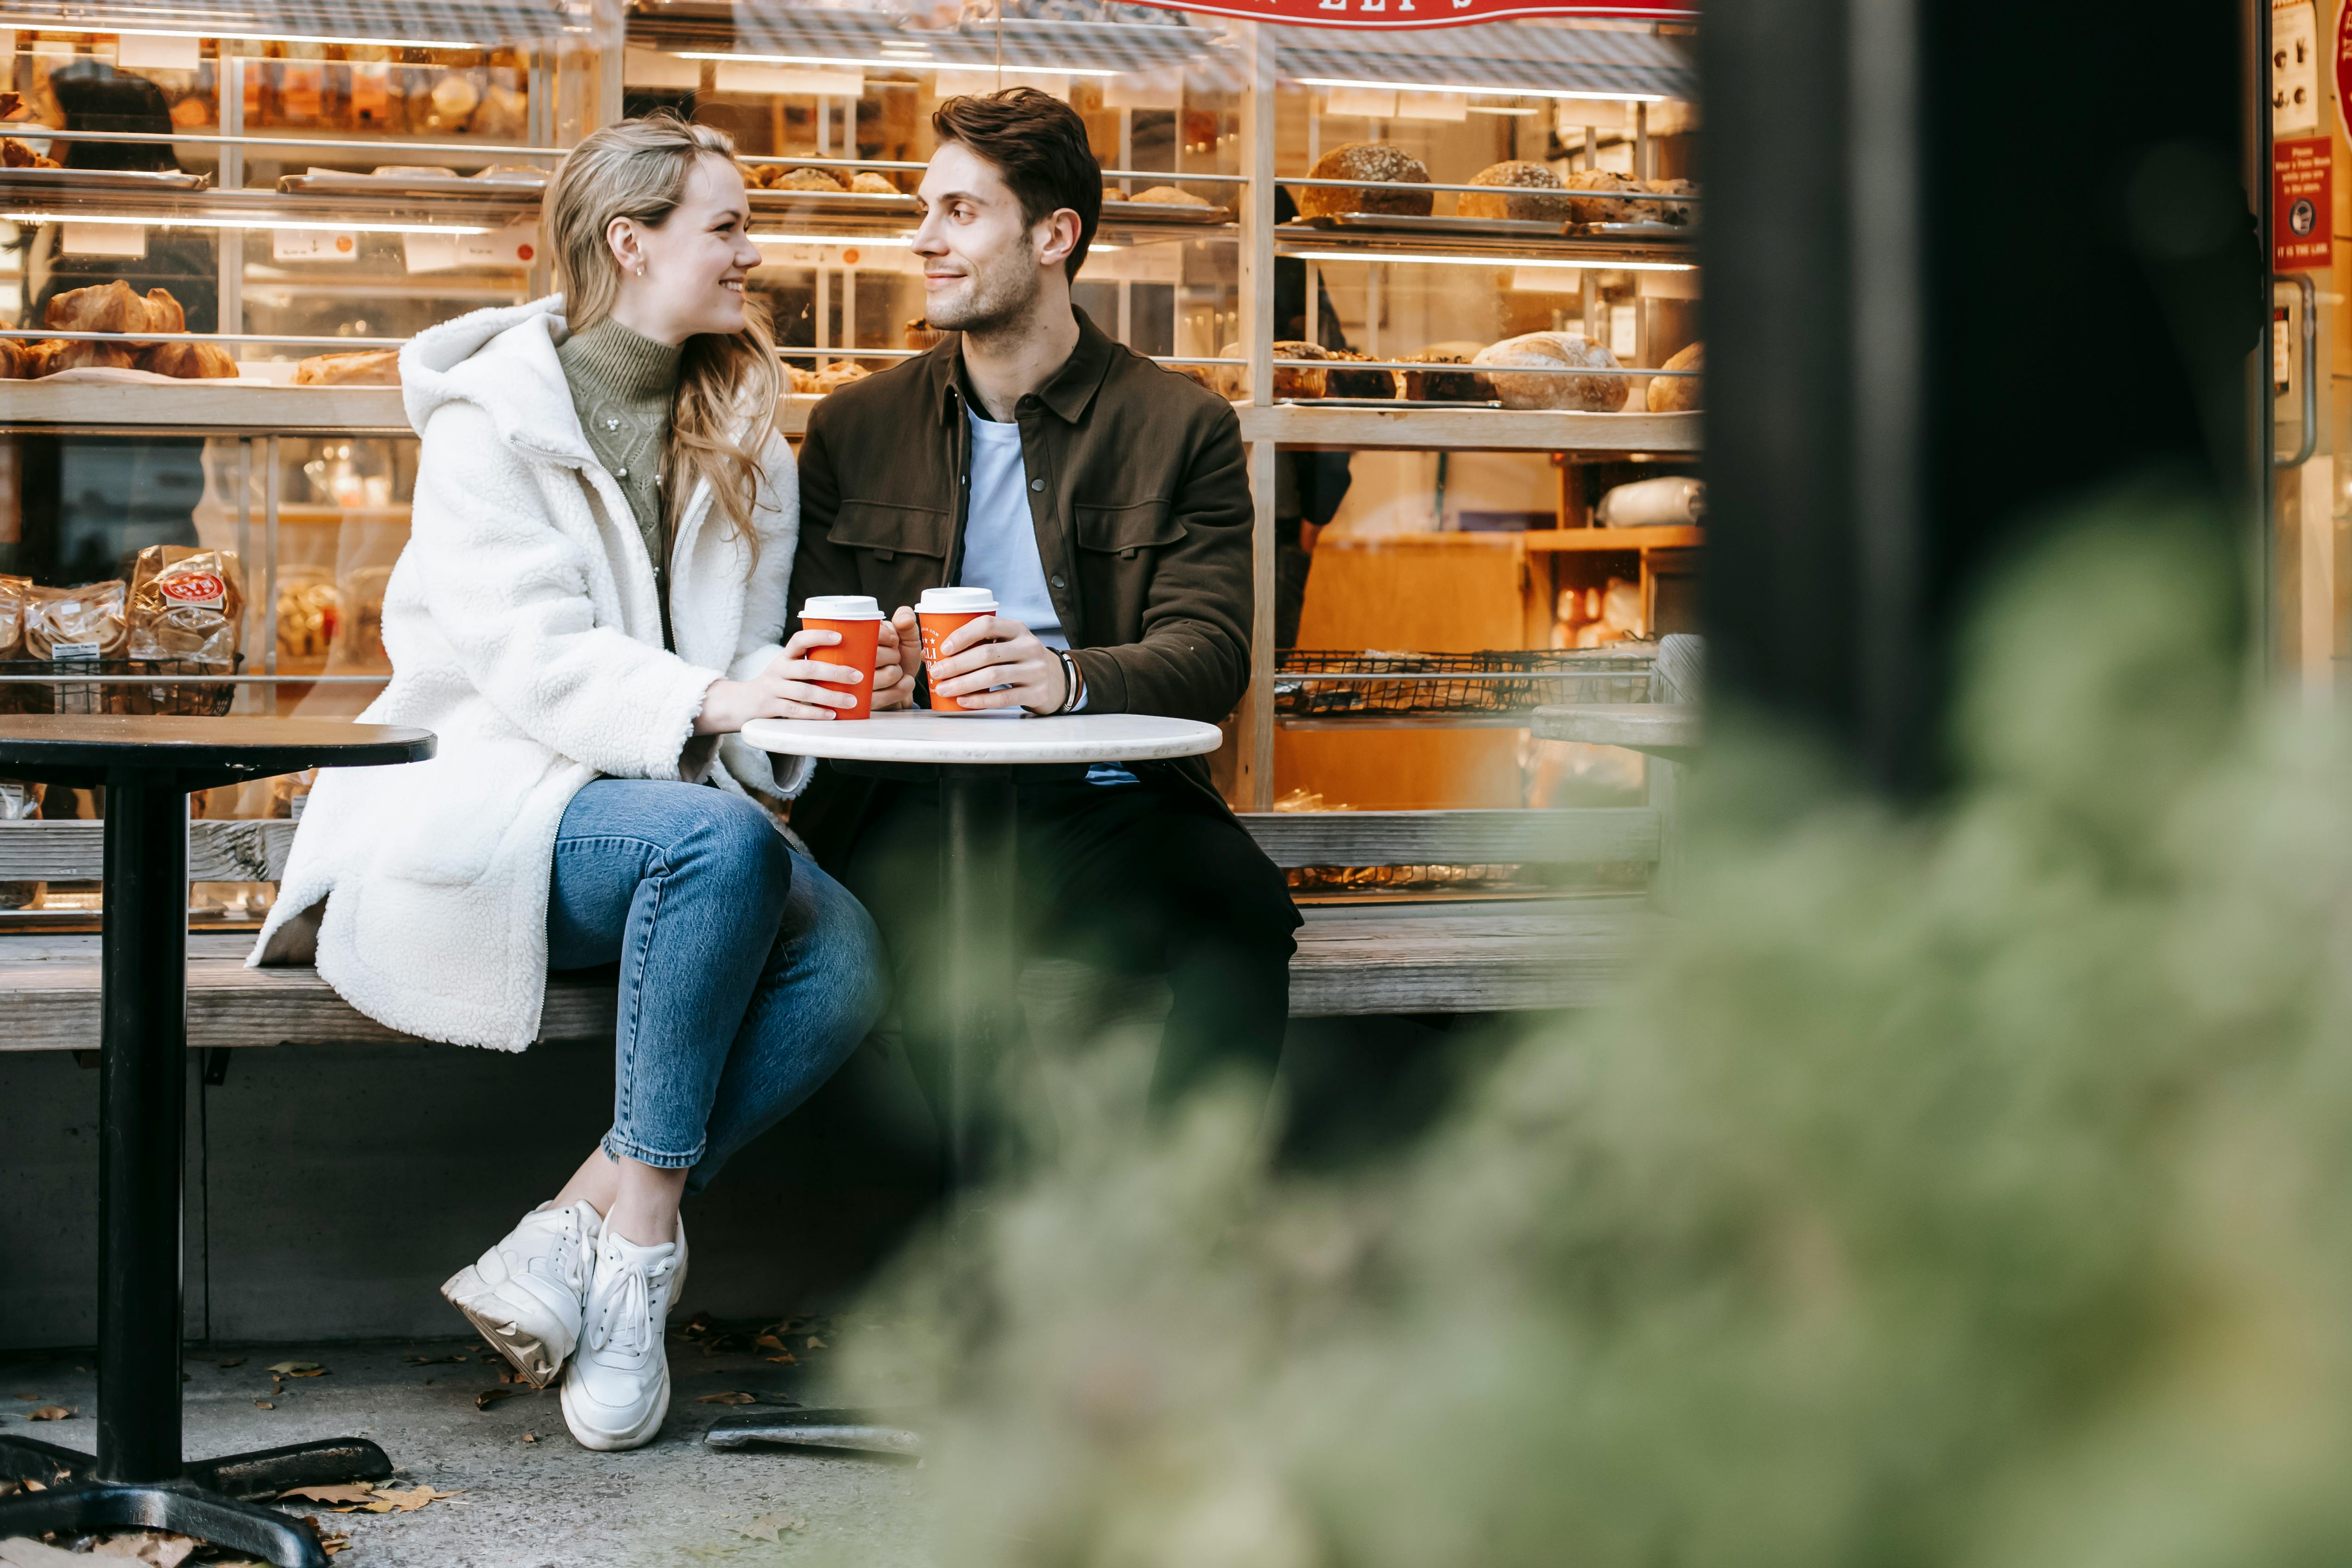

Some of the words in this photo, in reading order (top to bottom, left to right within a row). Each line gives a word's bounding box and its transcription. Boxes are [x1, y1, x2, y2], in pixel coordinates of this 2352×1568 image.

[2277, 247, 2284, 258] IT
[2286, 246, 2294, 258] IS
[2295, 244, 2308, 256] THE
